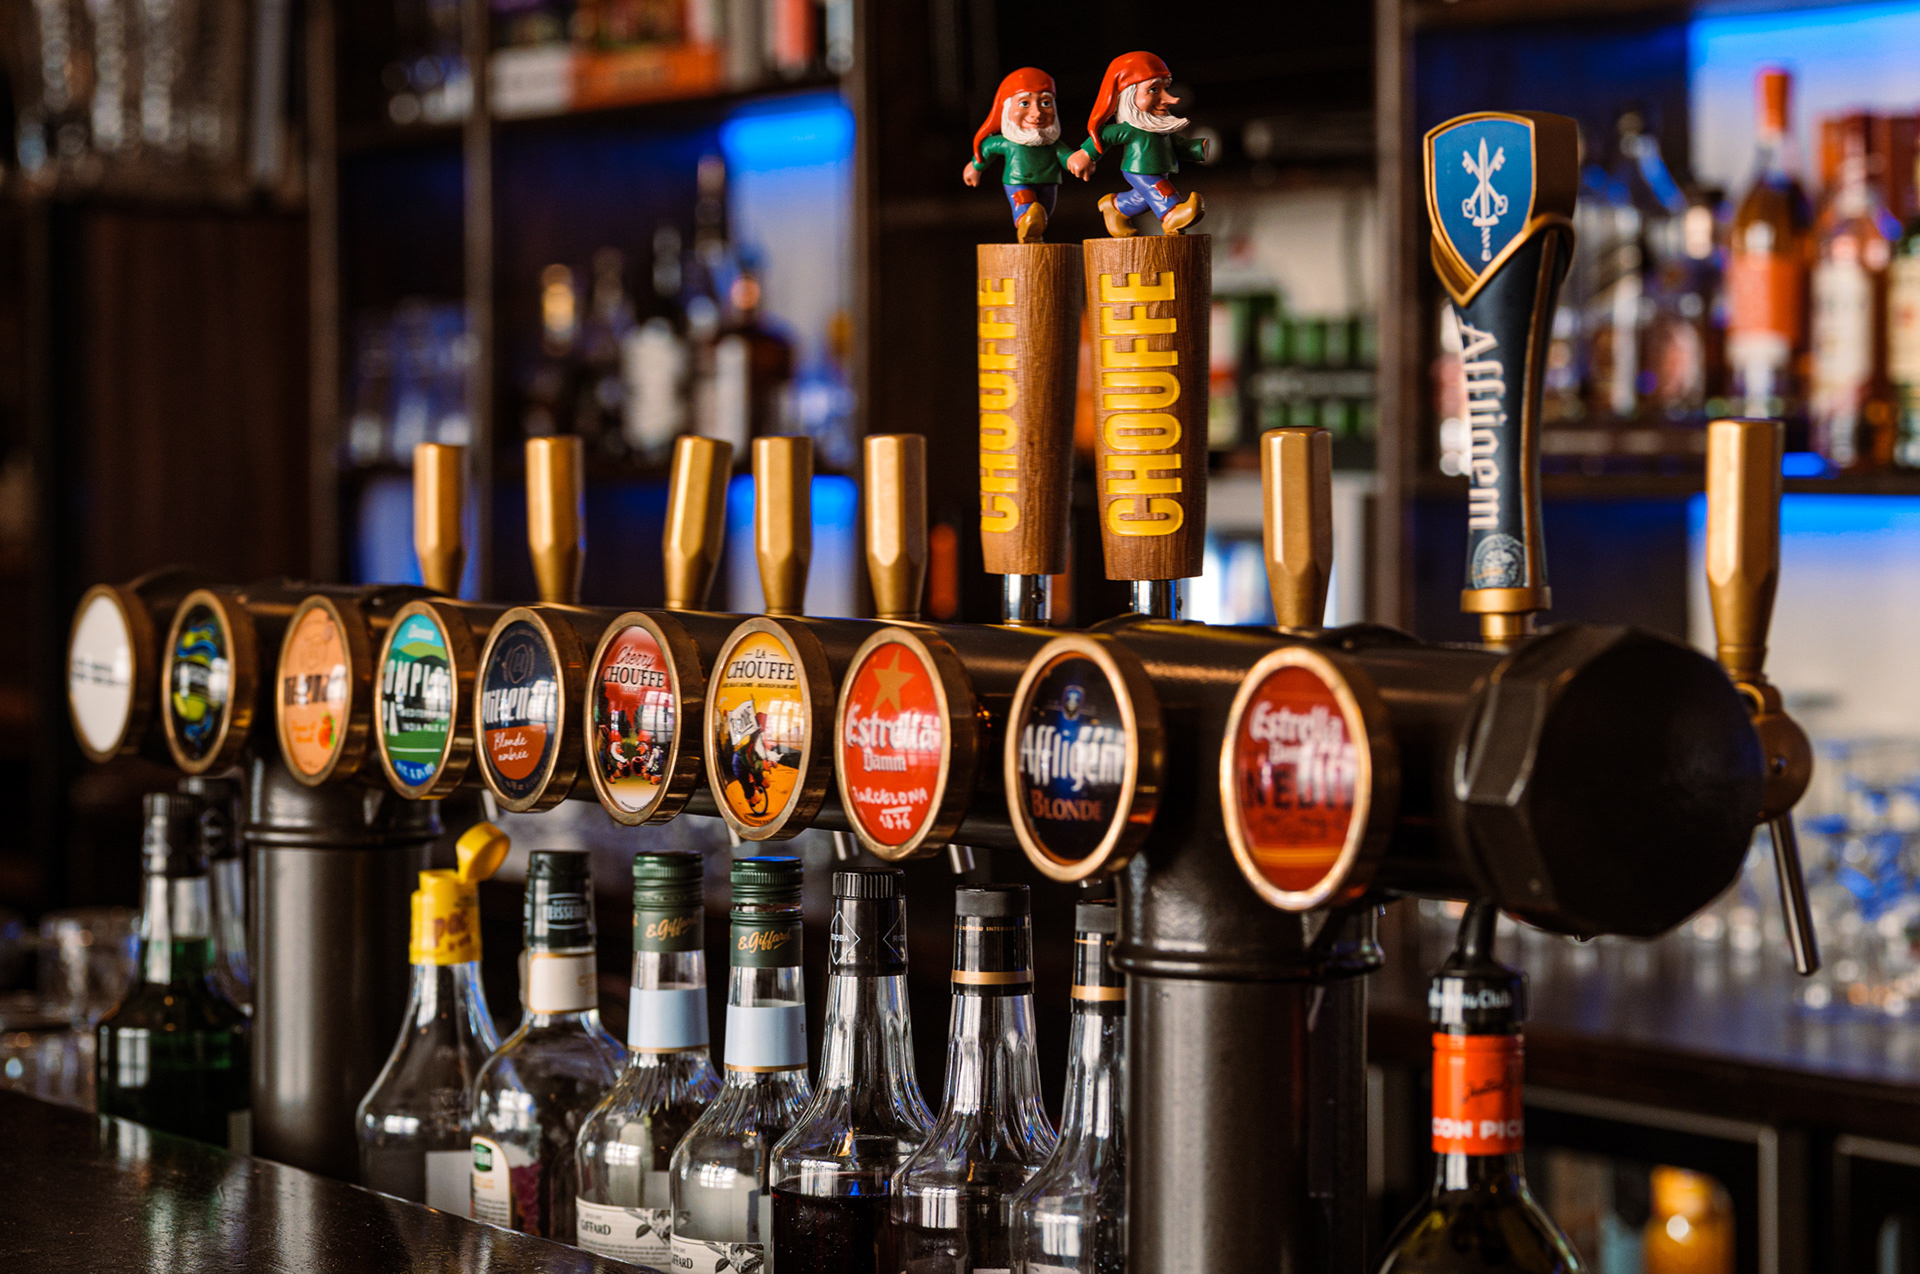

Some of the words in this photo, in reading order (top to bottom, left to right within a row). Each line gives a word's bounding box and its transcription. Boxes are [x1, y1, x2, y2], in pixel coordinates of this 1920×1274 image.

[978, 278, 1020, 533] CHOUFFE
[1099, 271, 1184, 537] CHOUFFE
[616, 645, 655, 668] Cherry
[755, 649, 766, 659] LA
[603, 665, 665, 688] CHOUFFE
[727, 660, 796, 681] CHOUFFE
[845, 701, 936, 752] Estrella
[1250, 701, 1345, 747] Estrella
[494, 731, 528, 751] Blonde
[863, 747, 907, 772] Damm
[1019, 723, 1125, 792] Affligem
[1031, 788, 1101, 822] BLONDE
[830, 933, 850, 942] RIOBA
